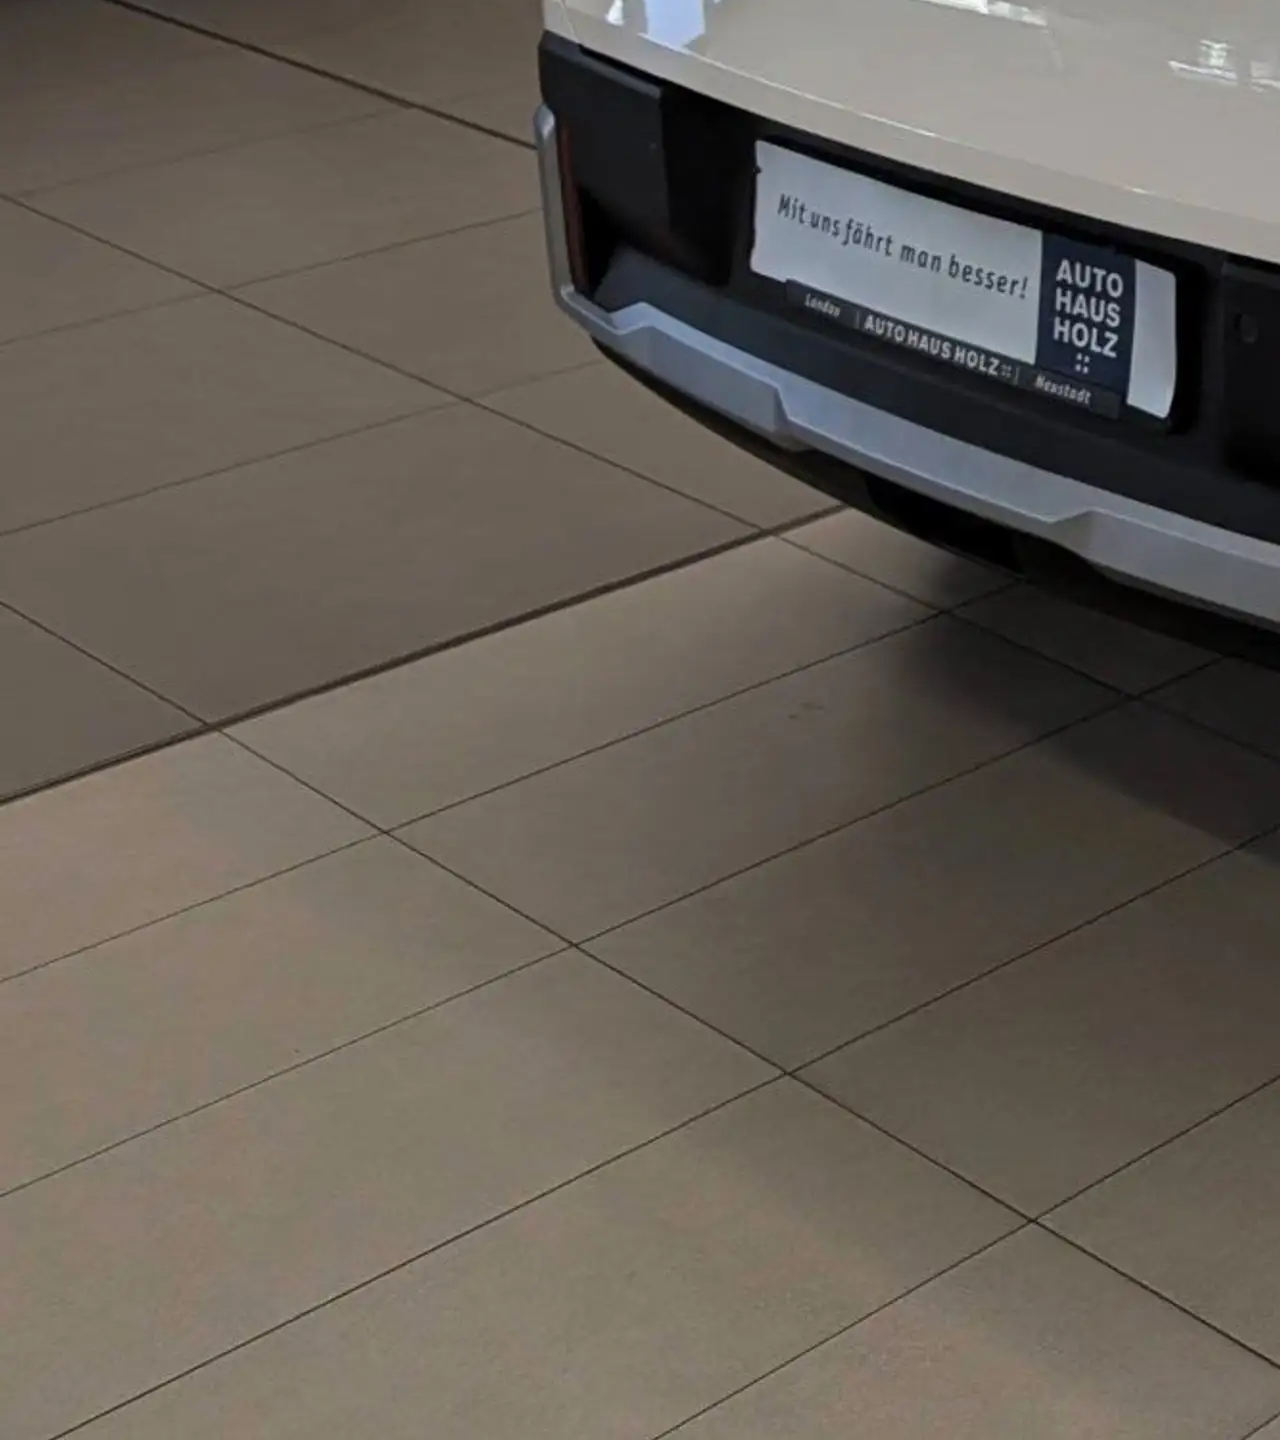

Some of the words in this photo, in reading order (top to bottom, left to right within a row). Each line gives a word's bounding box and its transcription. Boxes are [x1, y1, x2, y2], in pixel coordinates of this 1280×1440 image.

[777, 193, 806, 226] Mit
[809, 212, 841, 238] uns
[841, 215, 894, 258] fährt
[900, 244, 942, 273] man
[948, 252, 1028, 301] besser!
[1055, 258, 1125, 298] AUTO
[1054, 289, 1121, 328] HAUS
[1052, 316, 1119, 359] HOLZ
[954, 343, 1000, 377] HOLZ
